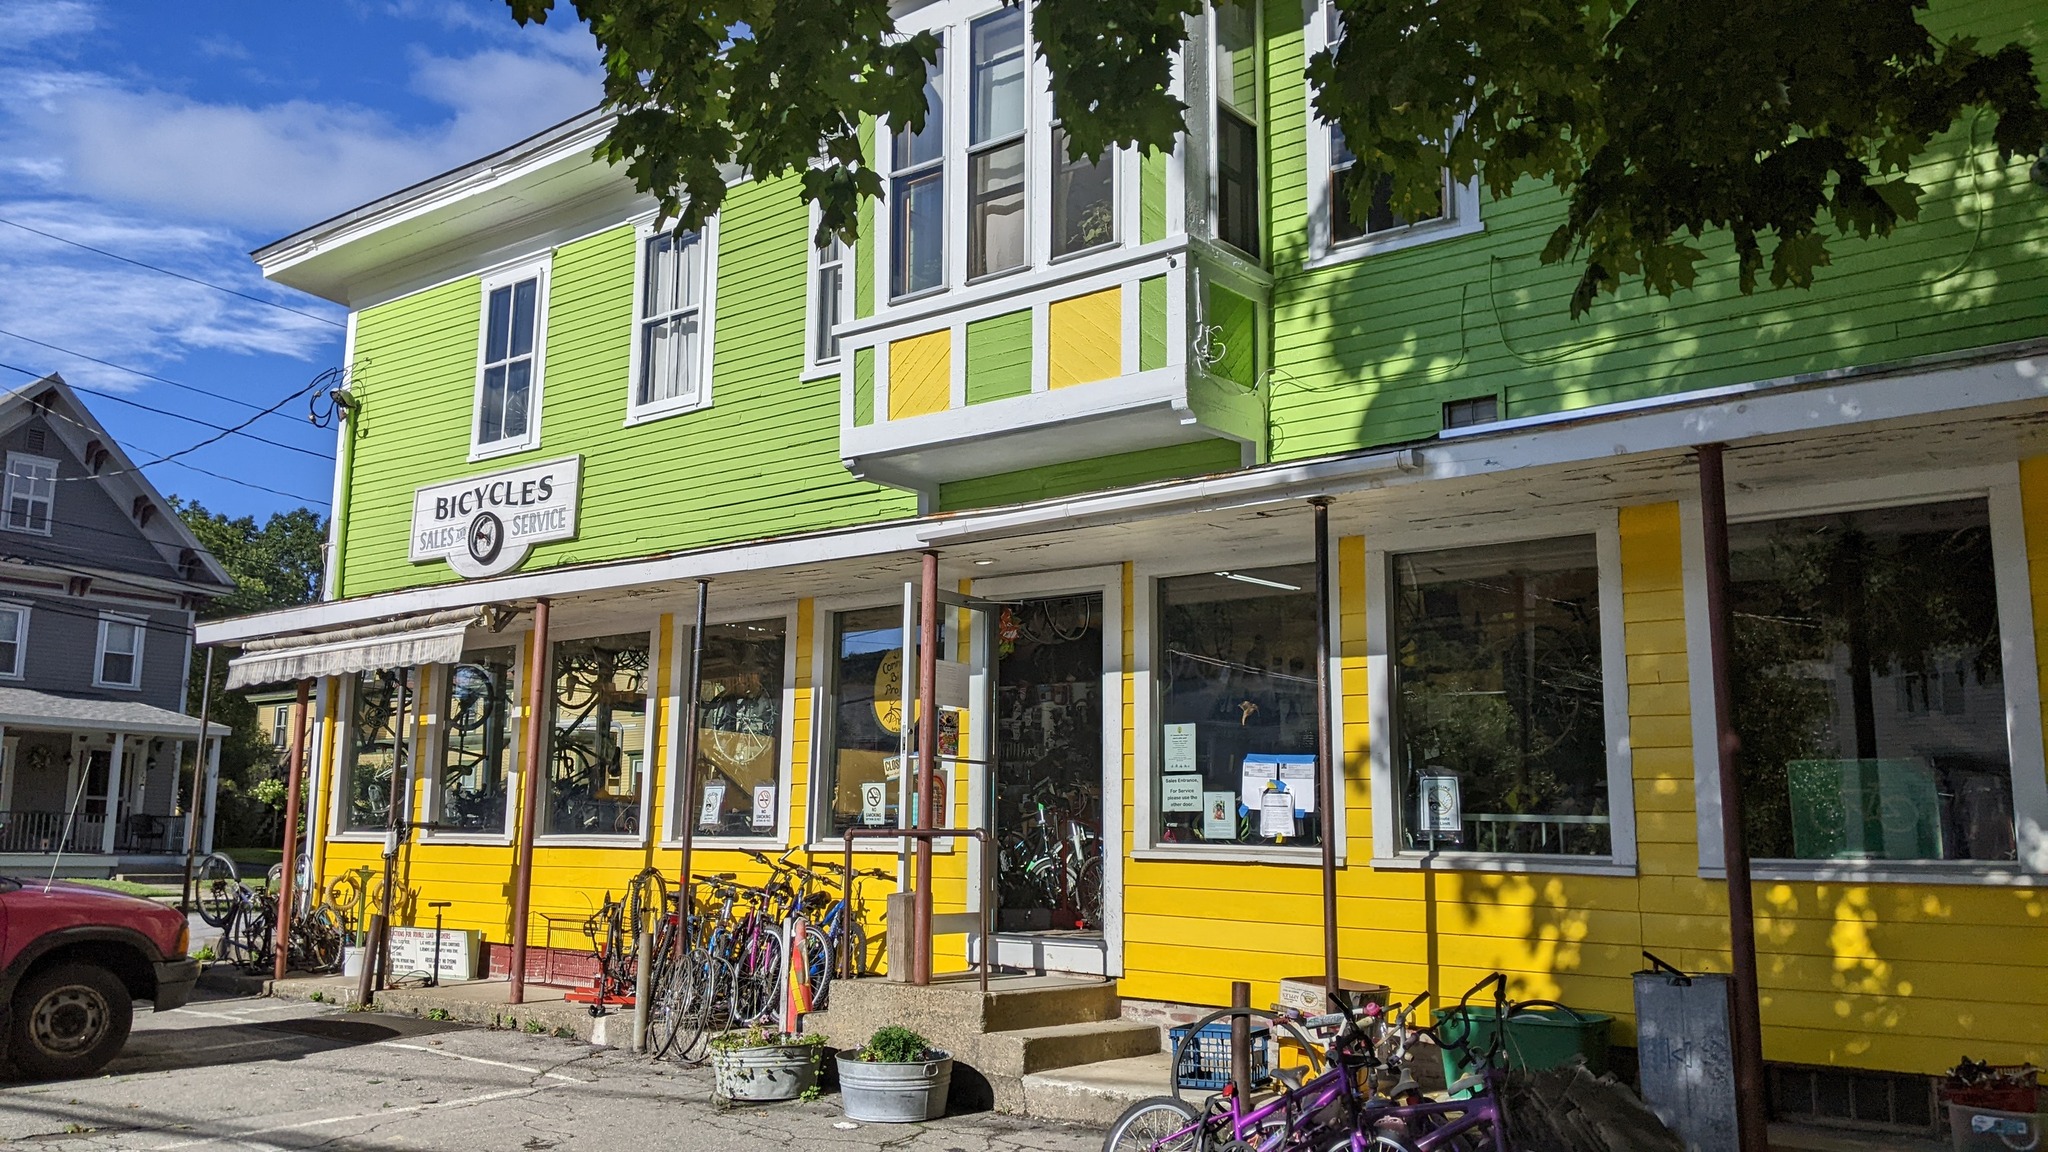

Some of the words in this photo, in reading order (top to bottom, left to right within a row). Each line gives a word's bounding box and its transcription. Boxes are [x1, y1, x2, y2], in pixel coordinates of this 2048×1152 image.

[435, 474, 554, 520] BICYCLES
[420, 527, 454, 550] SALES
[455, 526, 467, 543] AND
[511, 507, 567, 536] SERVICE
[885, 759, 901, 772] CLOS
